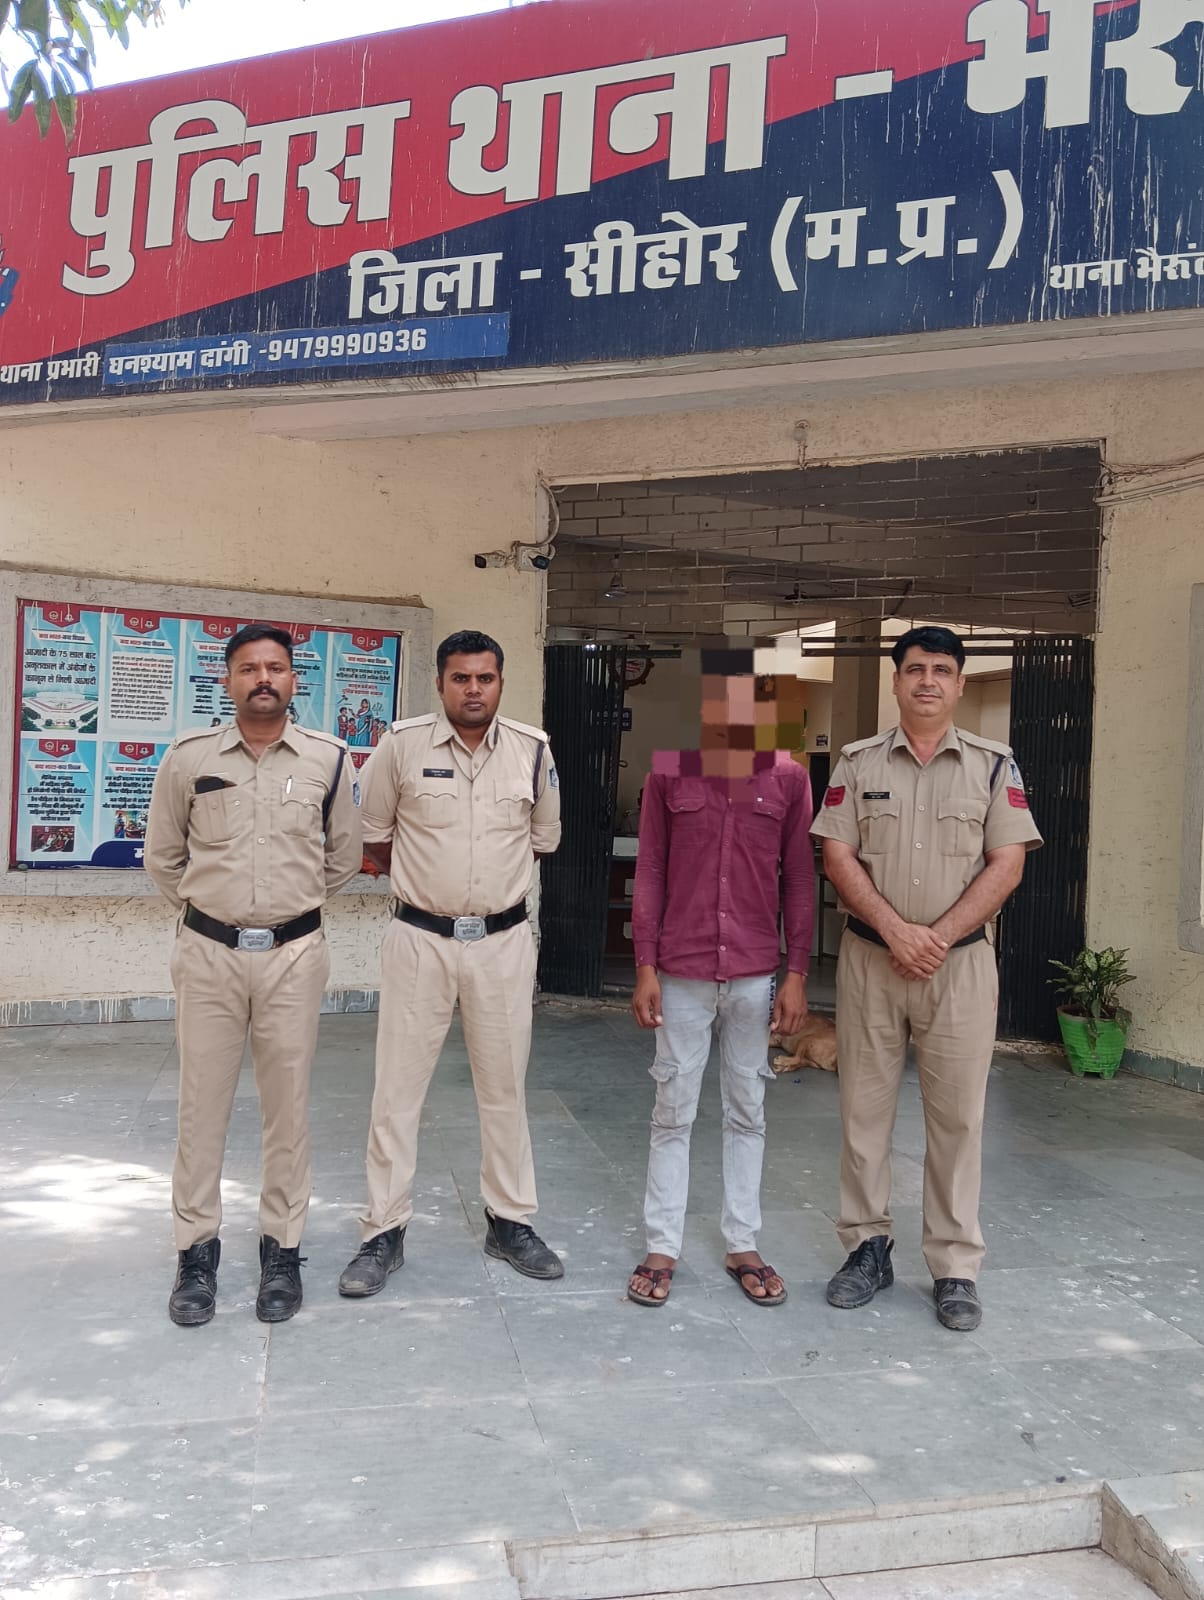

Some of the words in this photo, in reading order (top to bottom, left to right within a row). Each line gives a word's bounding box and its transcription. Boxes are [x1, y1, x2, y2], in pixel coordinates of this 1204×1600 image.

[63, 99, 411, 296] पुलिस
[448, 35, 787, 203] थाना
[348, 249, 502, 319] जिला
[565, 211, 748, 298] सीहोर
[1049, 259, 1127, 290] थाना
[1, 362, 43, 384] थाना
[47, 351, 101, 382] प्रभारी
[109, 350, 195, 376] घनश्याम
[200, 340, 252, 368] दांगी
[258, 327, 428, 362] -9479990936
[49, 648, 56, 657] के
[58, 650, 67, 658] 75
[69, 651, 84, 659] साल
[84, 652, 97, 660] बाद
[88, 663, 96, 672] के
